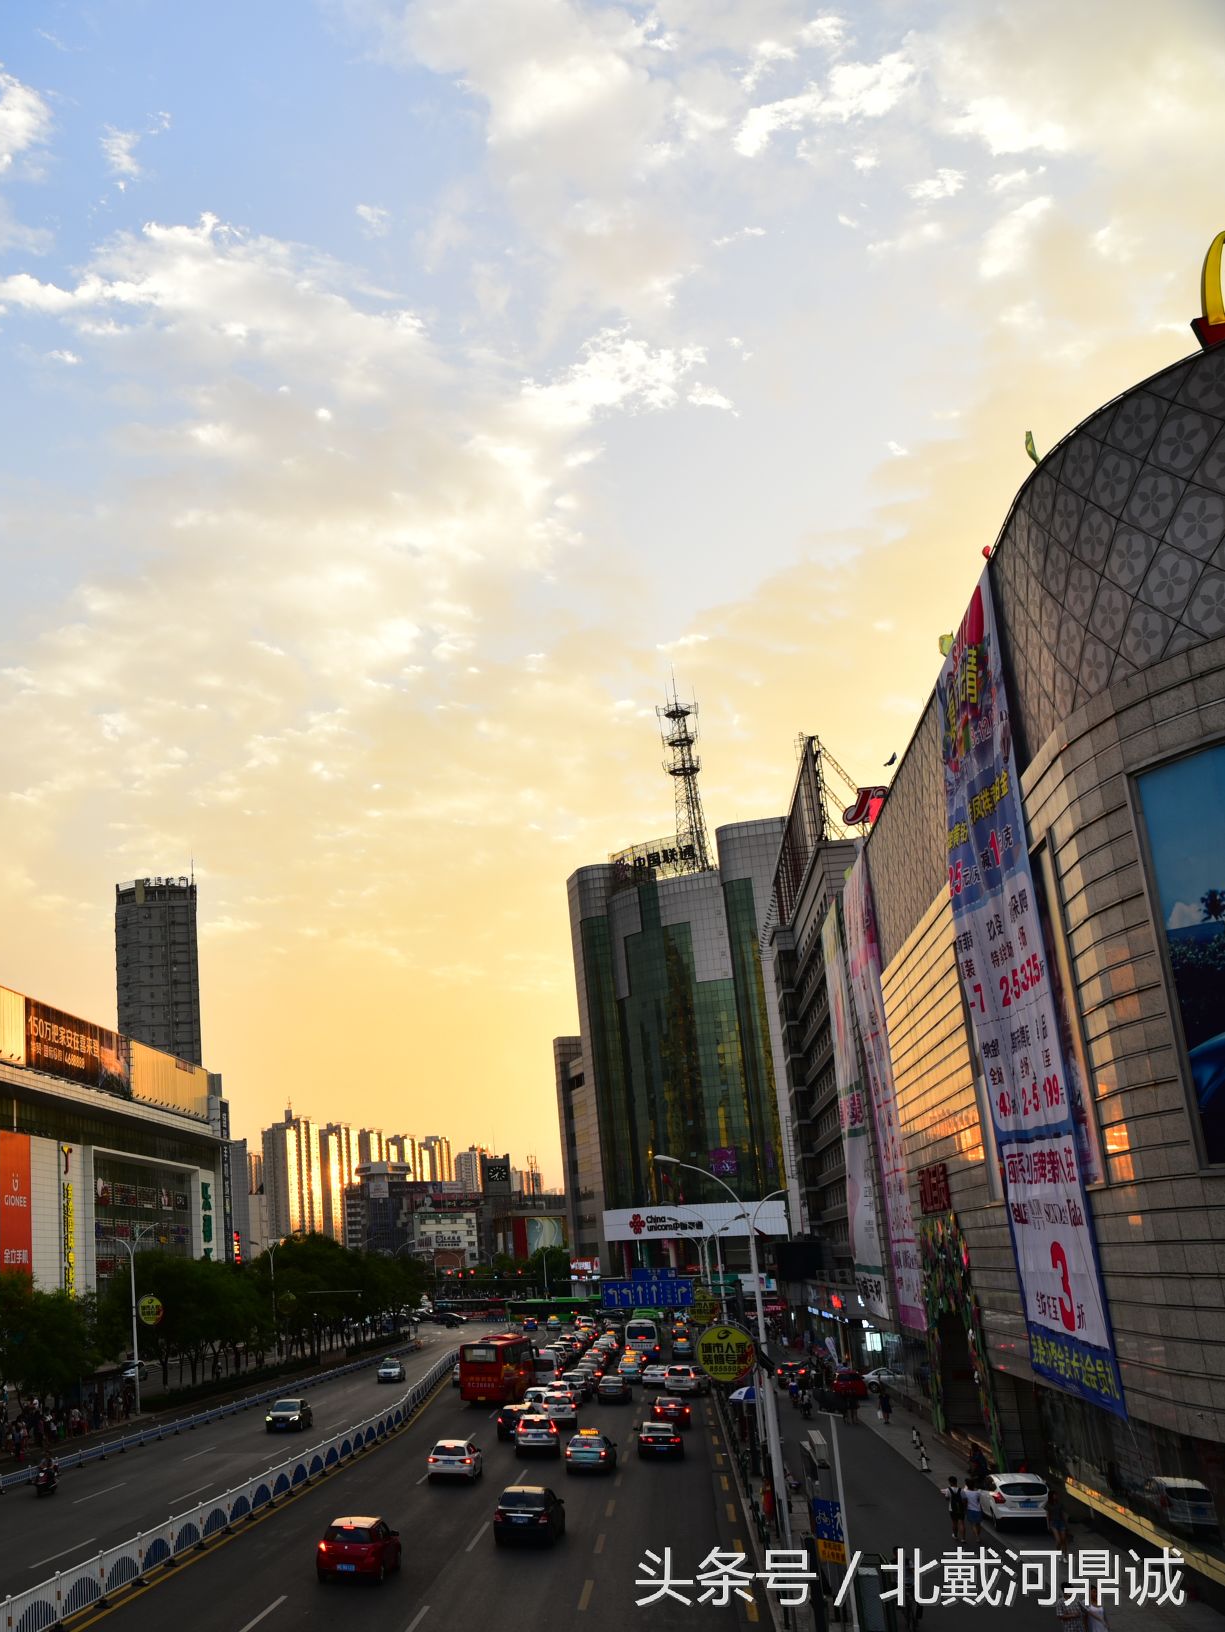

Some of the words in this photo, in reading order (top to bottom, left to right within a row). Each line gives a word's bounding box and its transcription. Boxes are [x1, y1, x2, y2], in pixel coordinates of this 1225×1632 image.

[633, 844, 696, 869] 中国联通
[4, 1194, 27, 1207] GIONEE
[646, 1215, 666, 1223] China
[647, 1223, 673, 1232] unicom
[4, 1249, 29, 1264] 金立手机
[701, 1342, 747, 1354] 城市人家
[702, 1354, 748, 1365] 装修专家
